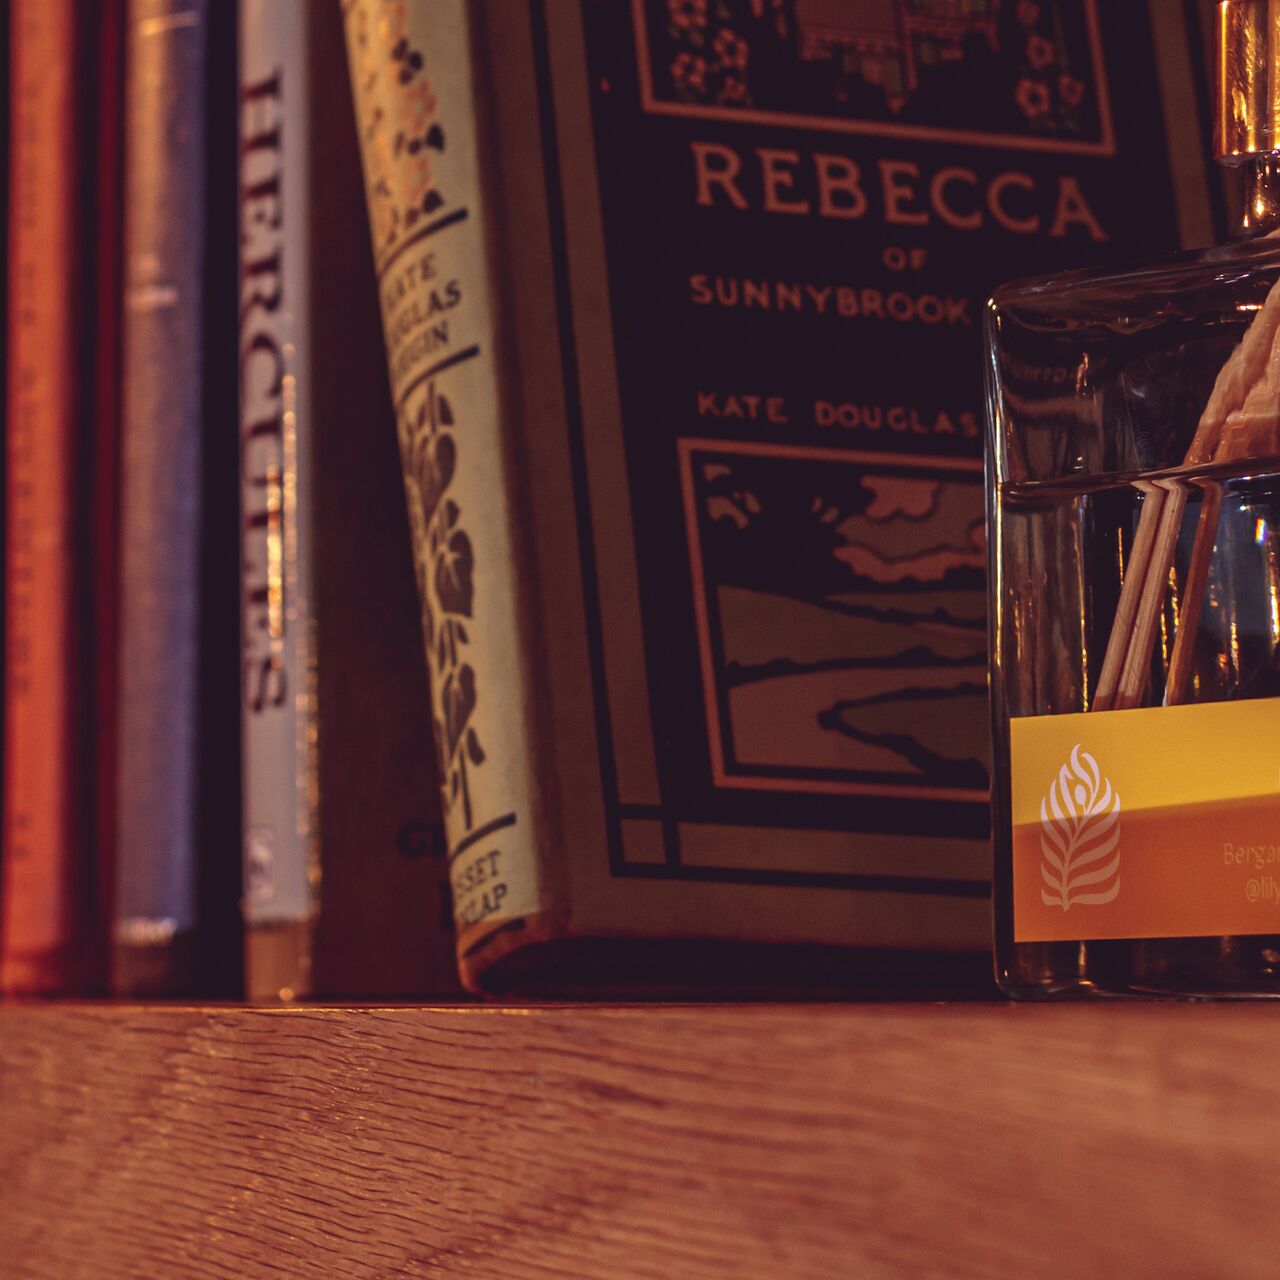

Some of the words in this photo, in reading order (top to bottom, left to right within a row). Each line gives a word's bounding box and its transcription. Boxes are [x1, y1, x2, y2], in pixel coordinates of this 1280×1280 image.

[690, 141, 1109, 242] REBECCA
[882, 246, 928, 272] OF
[689, 273, 973, 327] SUNNYBROOK
[242, 66, 287, 713] HERCULES
[696, 390, 788, 424] KATE
[813, 400, 980, 439] DOUGLAS
